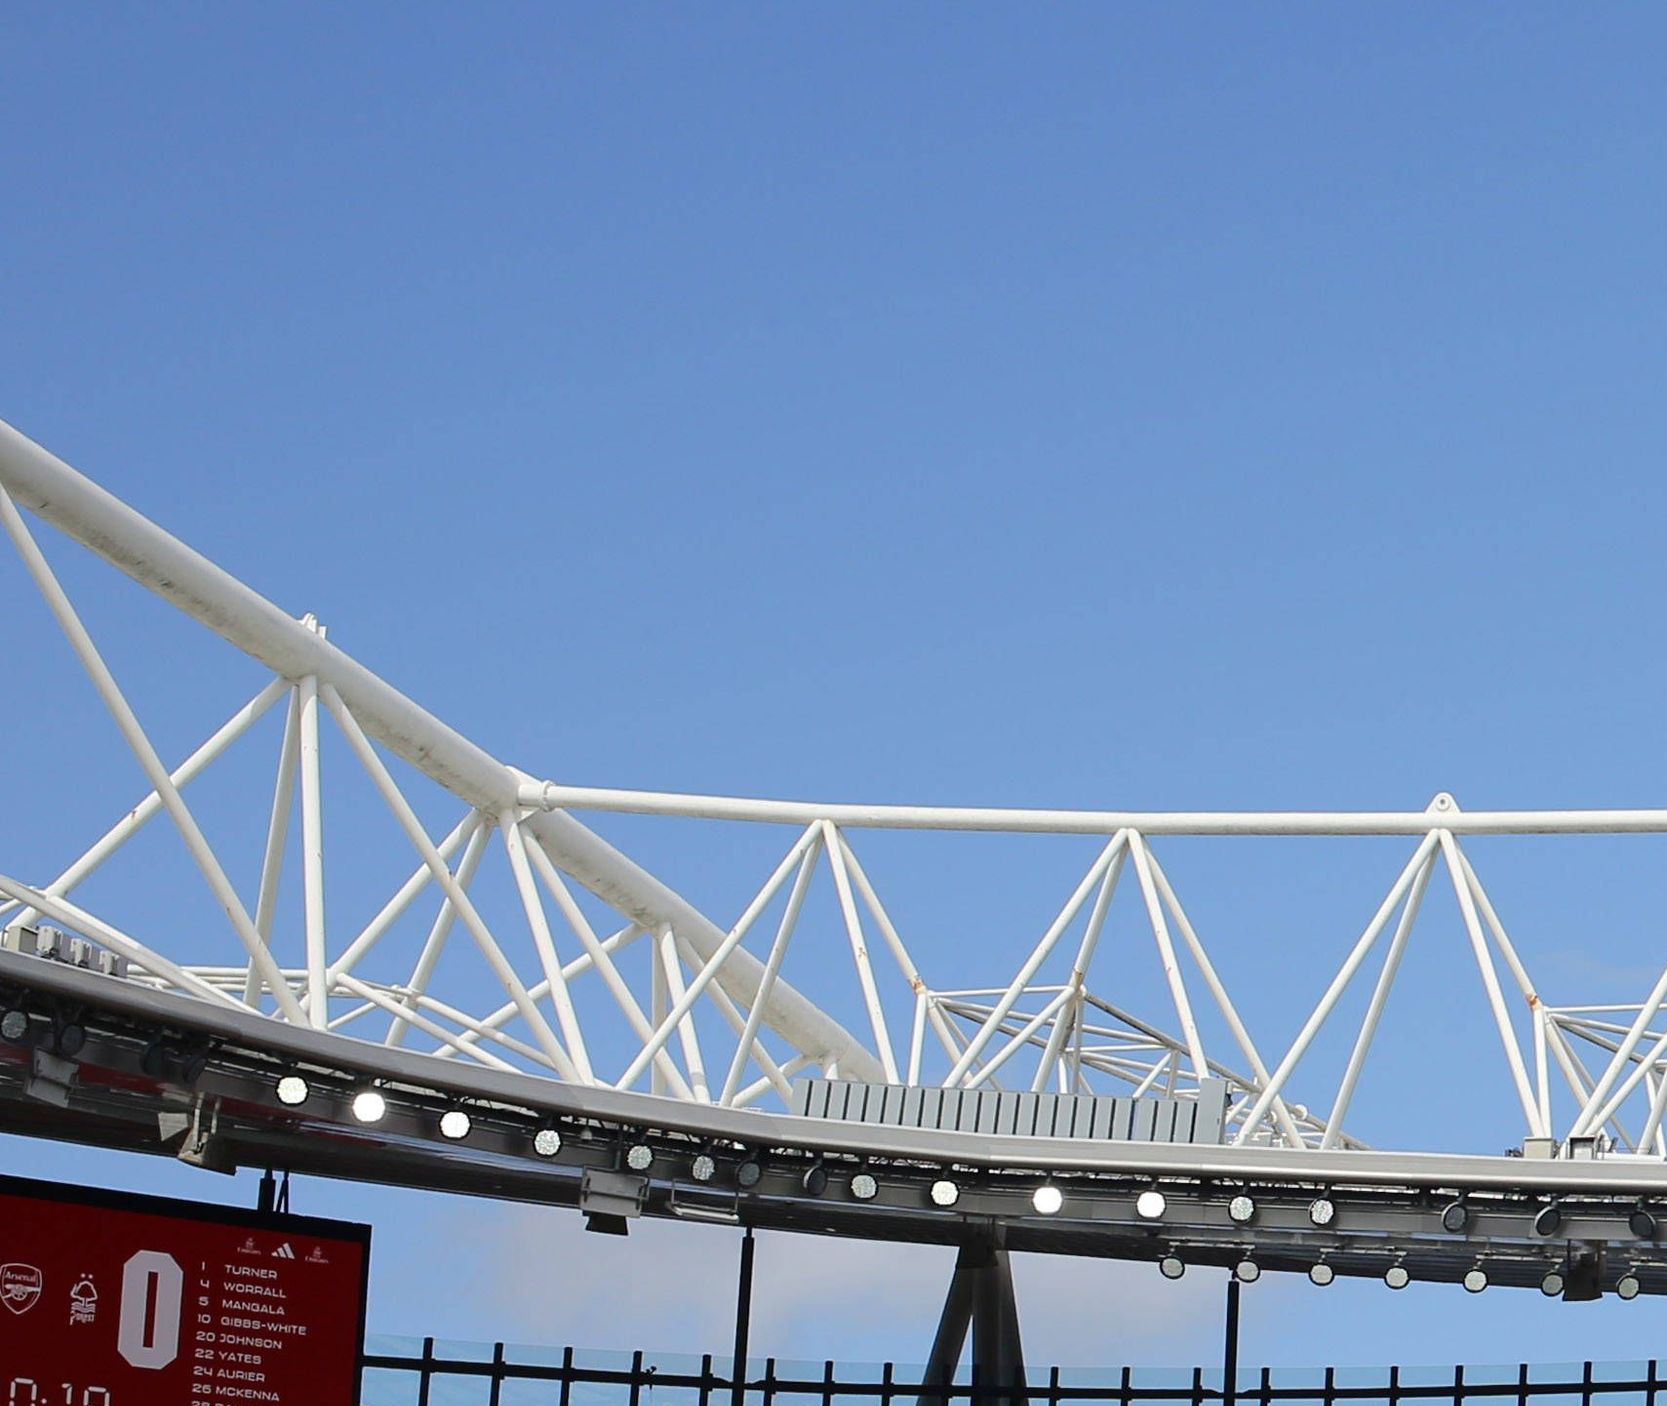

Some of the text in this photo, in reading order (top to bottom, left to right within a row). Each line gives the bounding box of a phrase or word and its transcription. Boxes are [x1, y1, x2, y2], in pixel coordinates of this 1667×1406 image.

[5, 1271, 38, 1283] Arsenal
[201, 1261, 278, 1280] 1 TURNER
[200, 1279, 287, 1299] 4 WORRALL
[118, 1250, 184, 1370] 0
[198, 1296, 285, 1315] 5 MANGALA
[198, 1313, 307, 1336] 10 GIBBS-WHITE
[196, 1331, 283, 1349] 20 JOHNSON
[194, 1348, 262, 1365] 22 YATES
[193, 1366, 266, 1382] 24 AURIER
[192, 1383, 280, 1402] 26 MCKENNA
